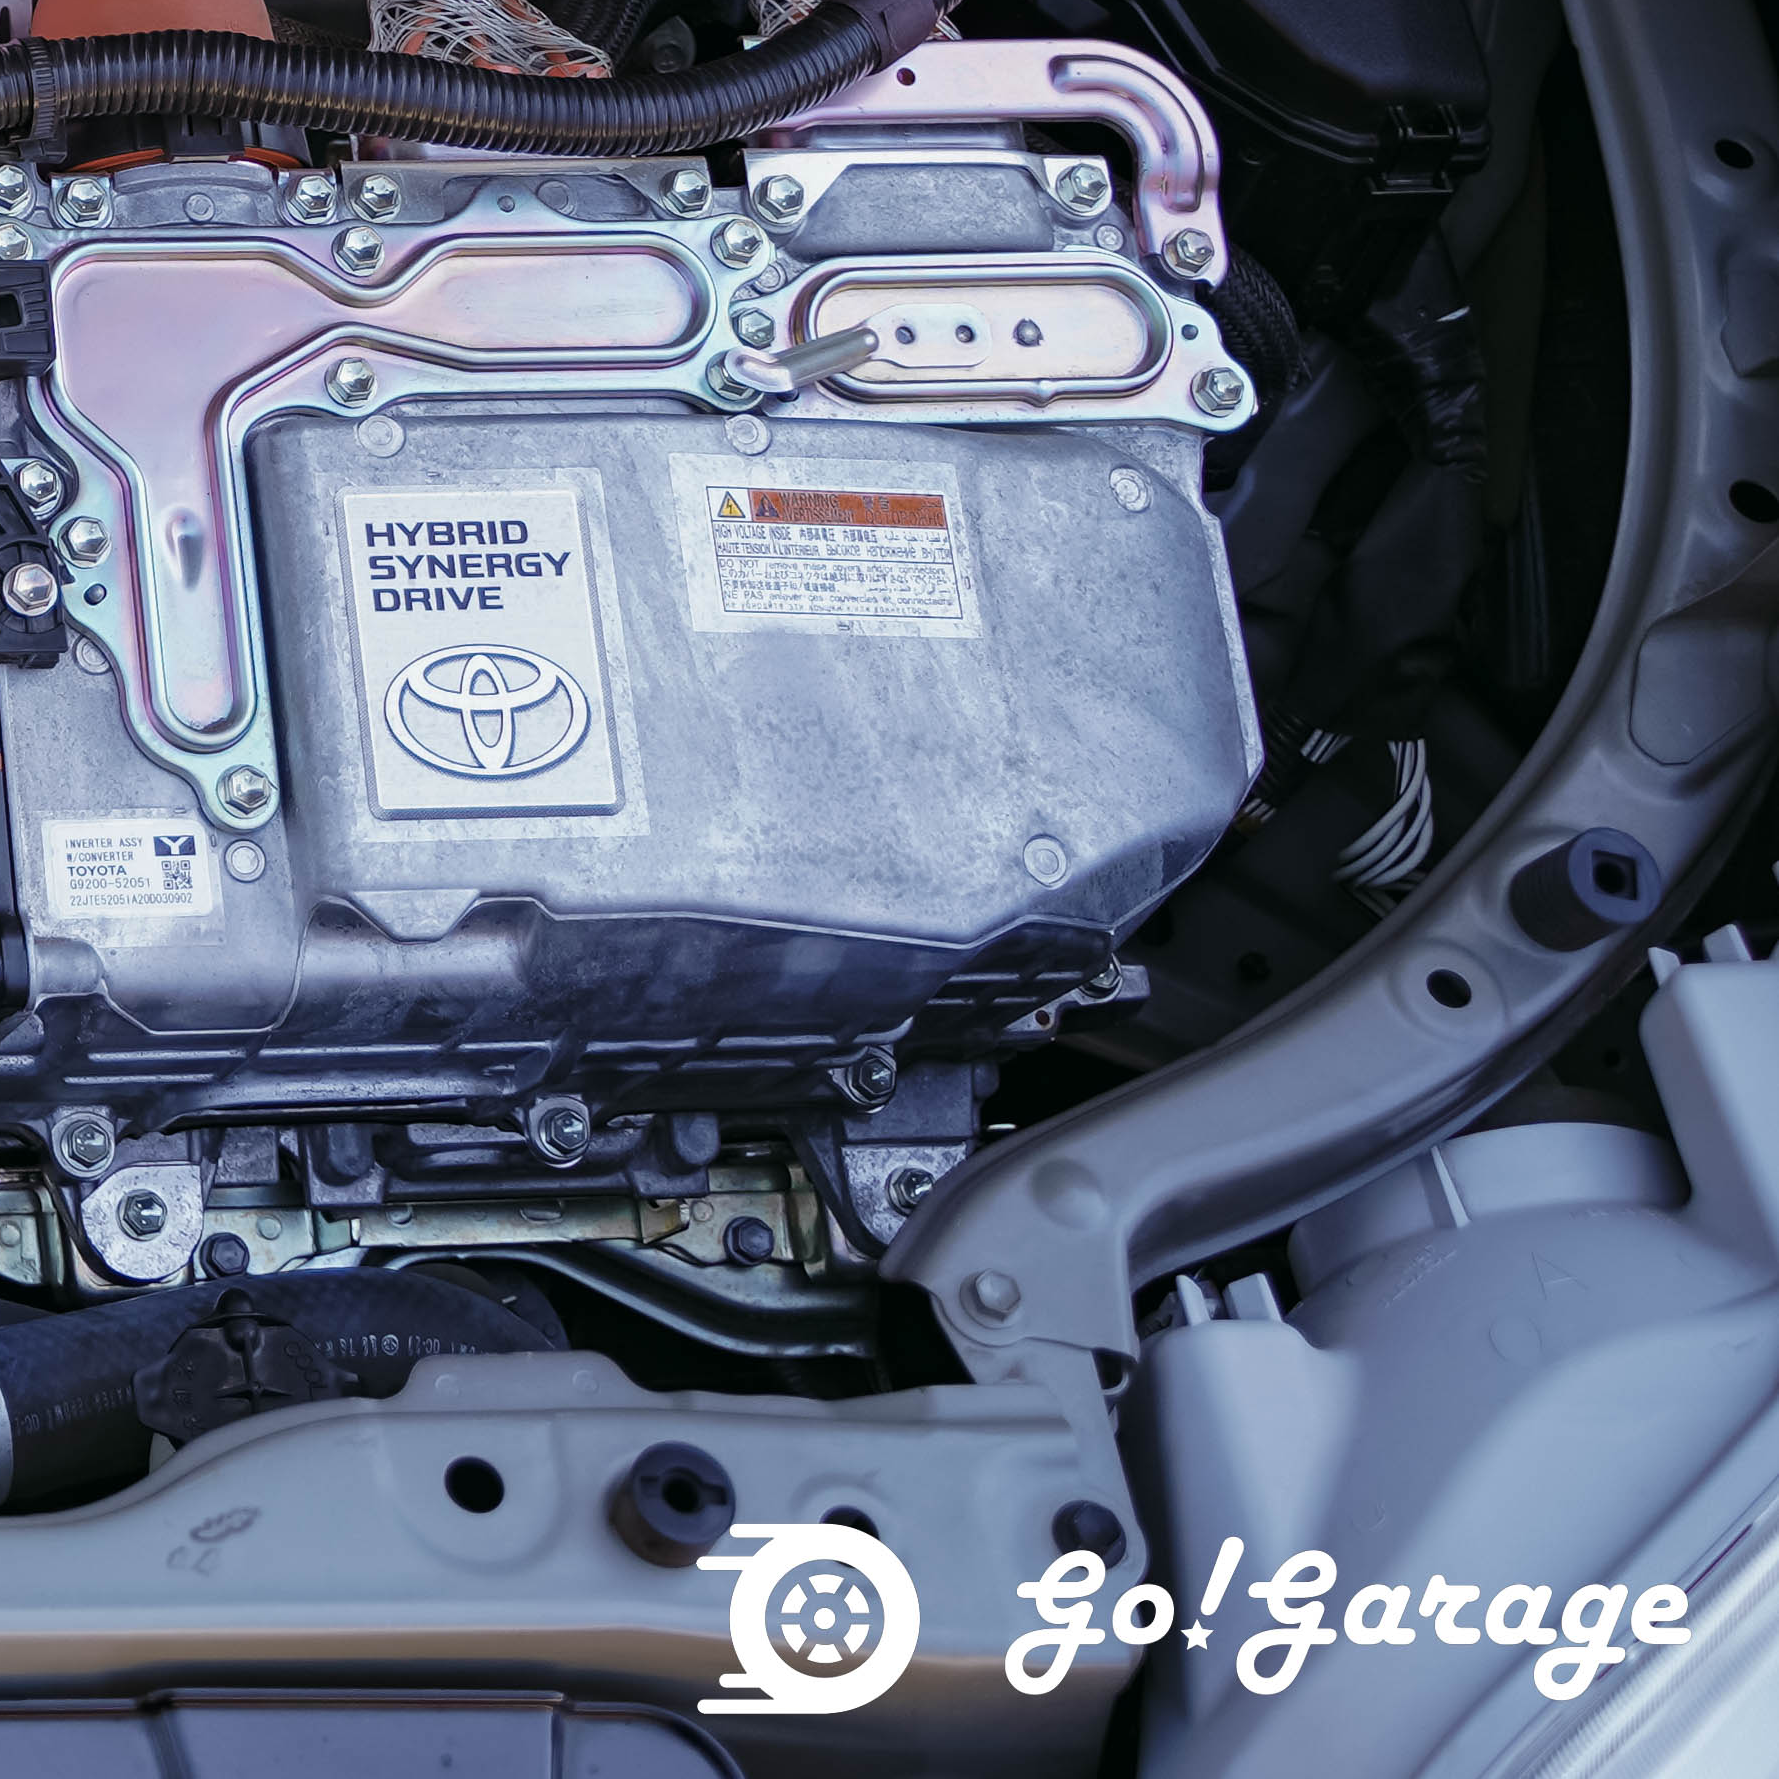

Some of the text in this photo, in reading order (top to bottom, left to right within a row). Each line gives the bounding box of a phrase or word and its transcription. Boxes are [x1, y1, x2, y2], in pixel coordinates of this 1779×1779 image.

[778, 491, 839, 508] WARNING
[364, 520, 529, 548] HYBRID
[713, 523, 792, 540] HIGH VOLTAGE INSIDE
[368, 551, 572, 580] SYNERGY
[718, 558, 734, 567] DO
[738, 559, 760, 568] NOT
[373, 584, 505, 612] DRIVE
[723, 590, 738, 598] NE
[743, 591, 763, 599] PAS
[65, 837, 143, 848] INVERTER ASSY
[67, 852, 134, 862] W/CONVERTER
[67, 865, 127, 876] TOYOTA
[70, 878, 151, 890] G9200-52051
